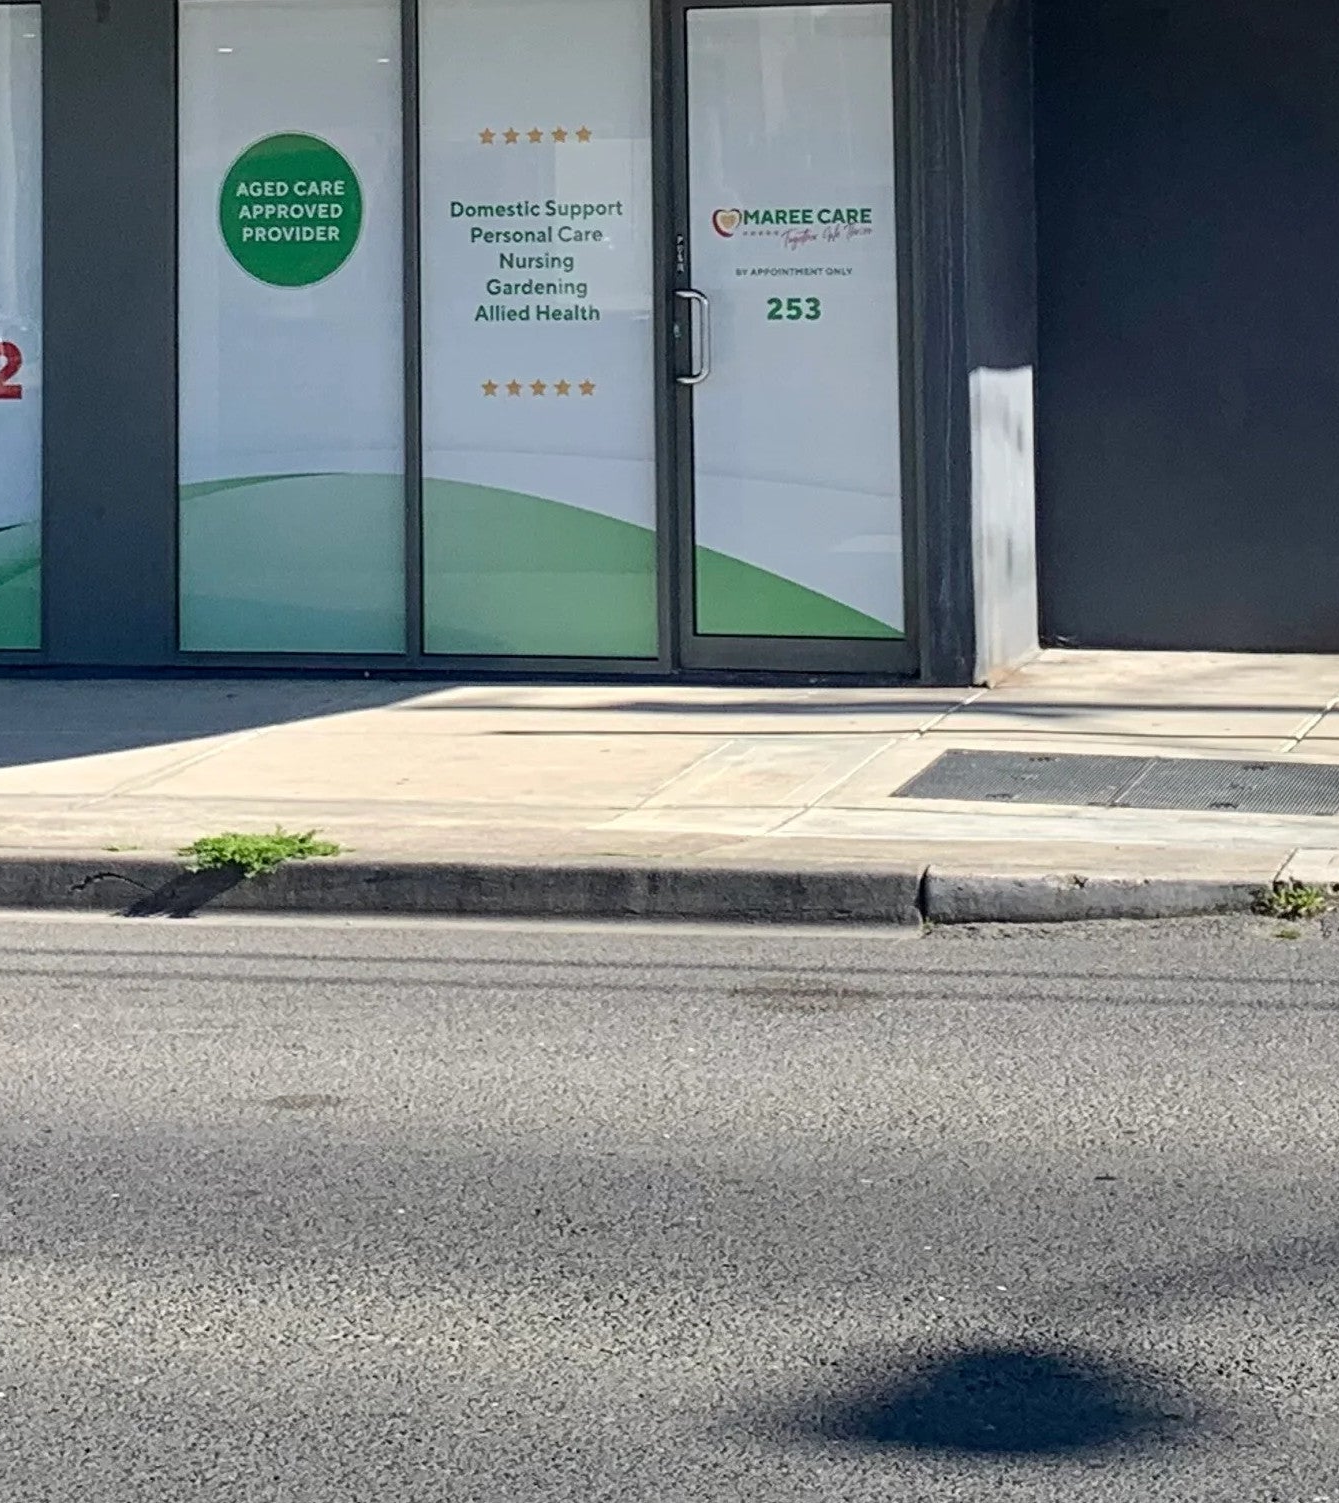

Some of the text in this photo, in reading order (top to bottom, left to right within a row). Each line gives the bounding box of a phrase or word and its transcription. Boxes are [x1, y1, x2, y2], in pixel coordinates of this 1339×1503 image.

[235, 180, 345, 197] AGED CARE
[238, 203, 343, 219] APPROVED
[450, 200, 623, 219] Domestic Support
[744, 208, 872, 225] MAREE CARE
[242, 226, 340, 242] PROVIDER
[471, 226, 603, 243] Personal Care
[499, 252, 574, 271] Nursing
[486, 278, 587, 297] Gardening
[475, 304, 600, 321] Allied Health
[767, 297, 821, 321] 253
